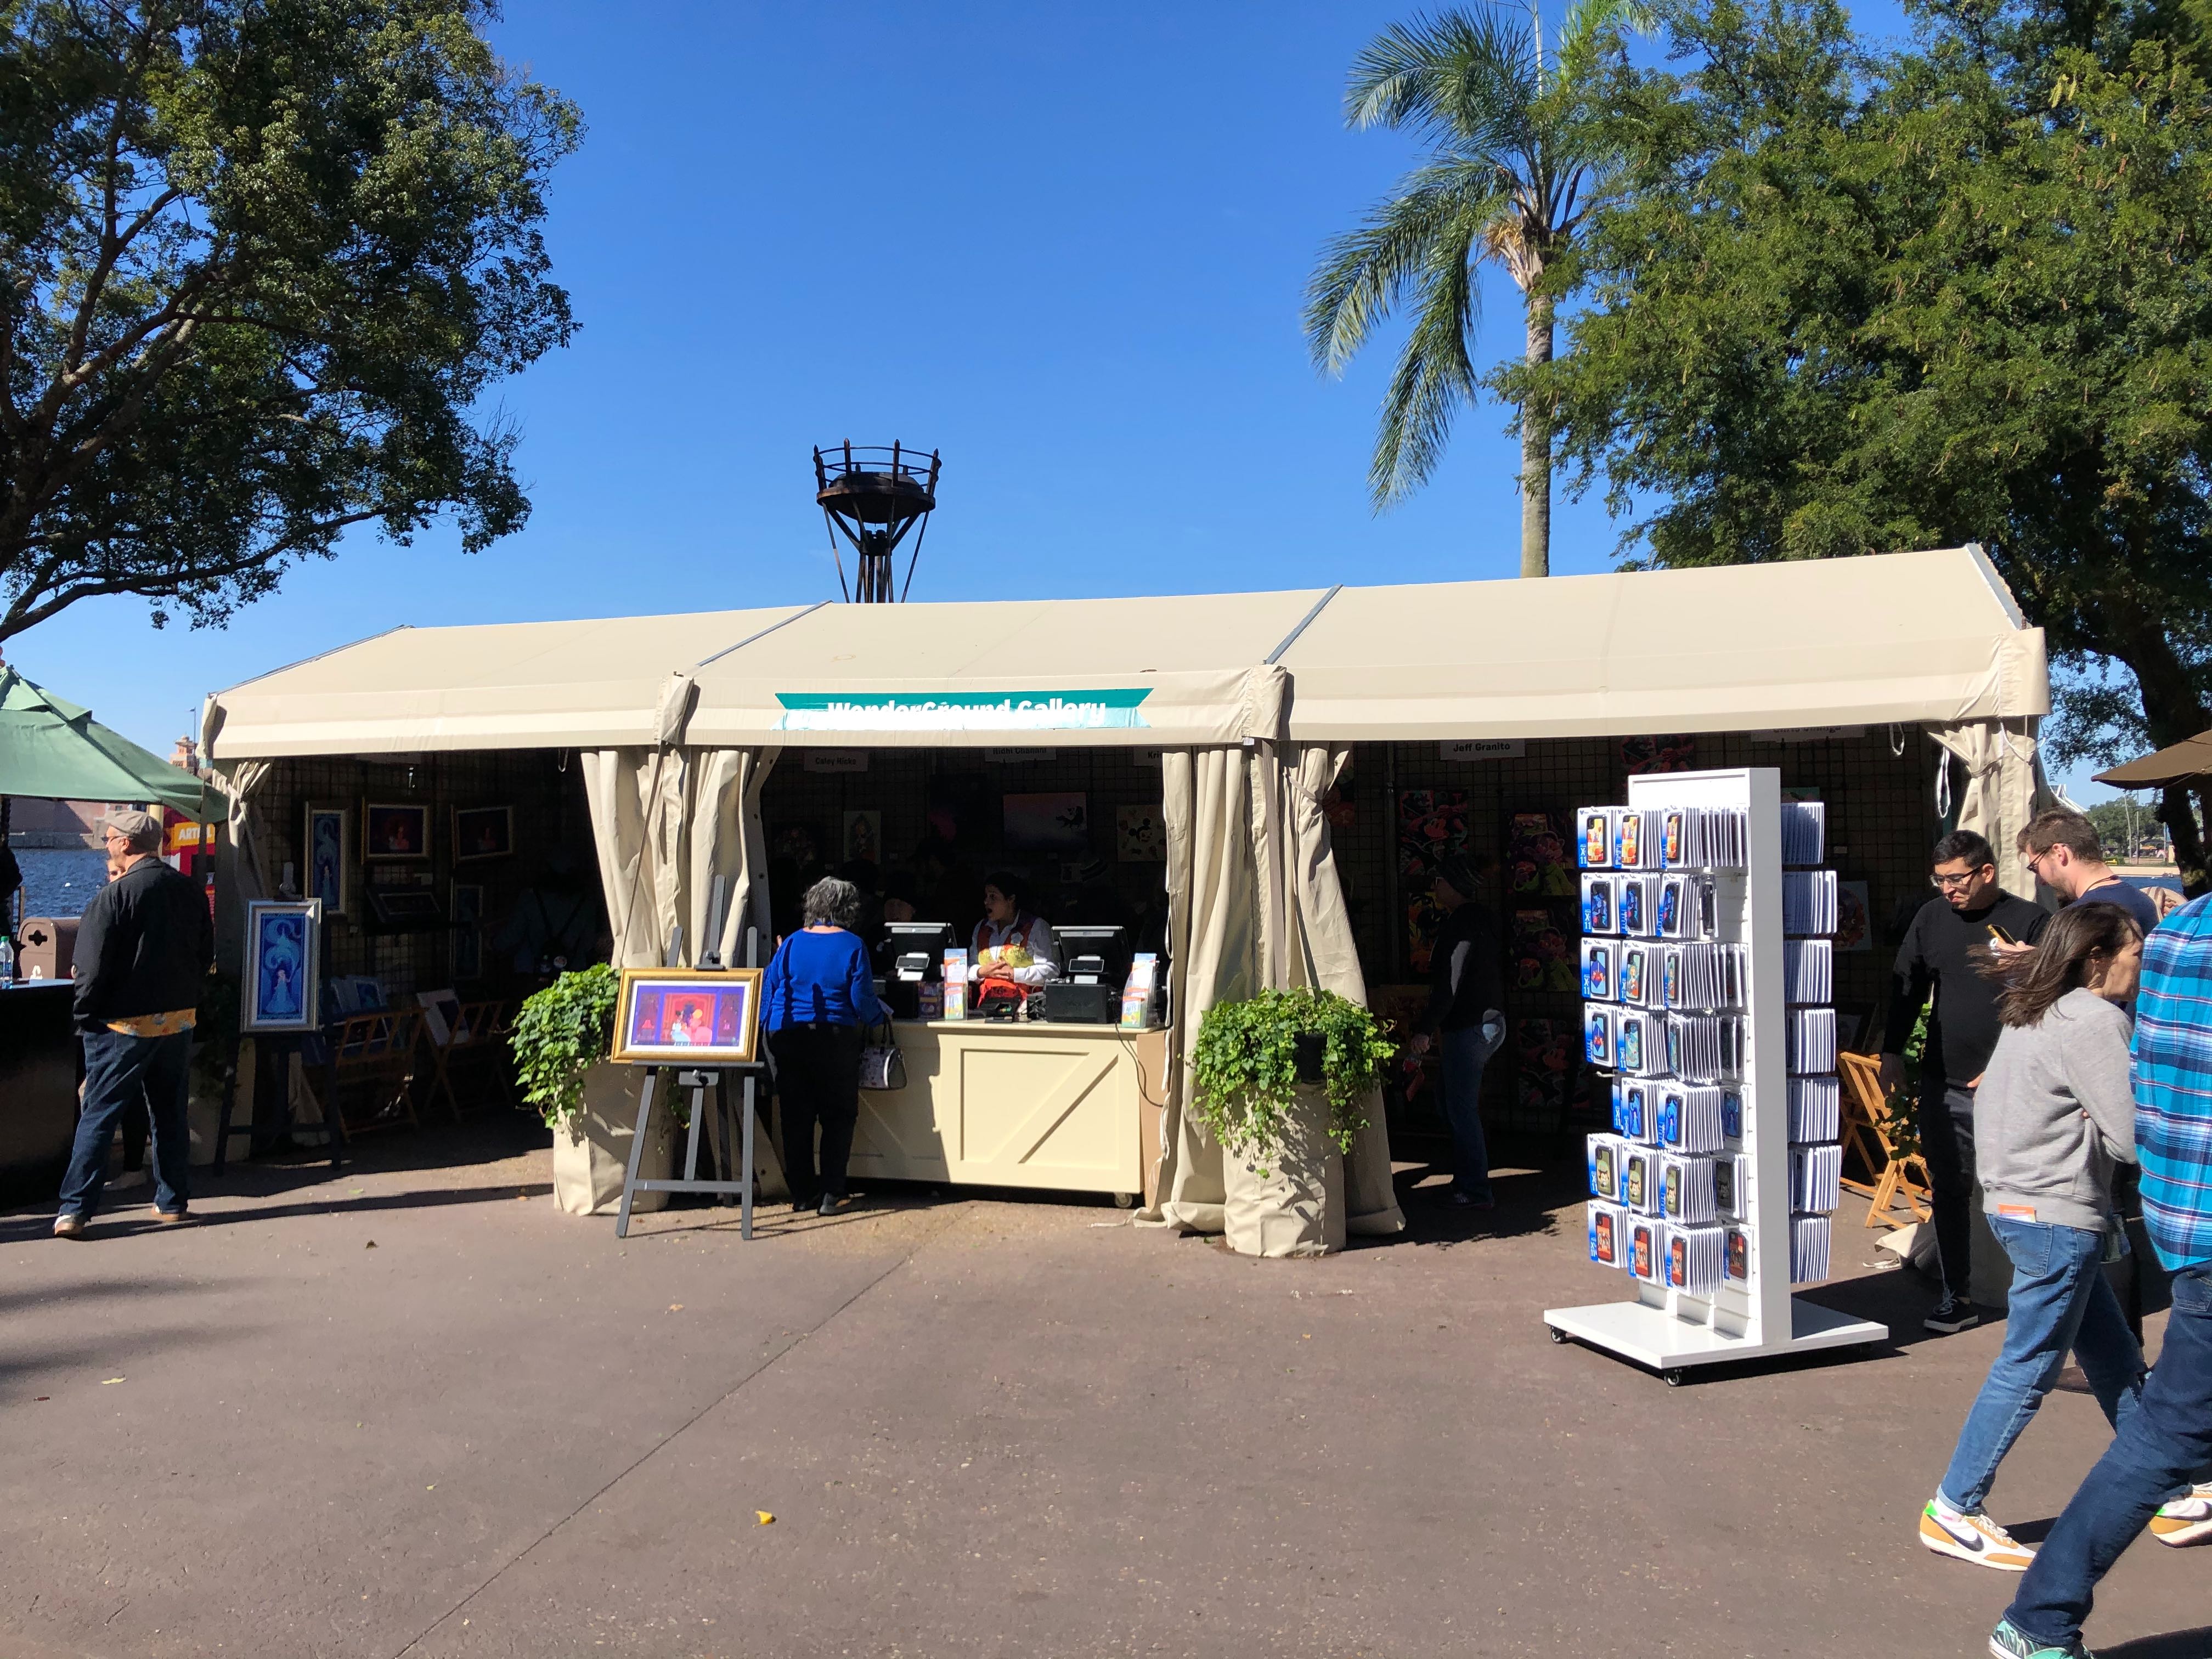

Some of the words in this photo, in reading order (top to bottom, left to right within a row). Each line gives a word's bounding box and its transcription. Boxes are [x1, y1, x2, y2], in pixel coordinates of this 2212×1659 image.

[1453, 742, 1472, 752] Jeff
[1475, 742, 1511, 751] Granito
[1148, 751, 1162, 759] Kri
[178, 826, 212, 840] ARTL
